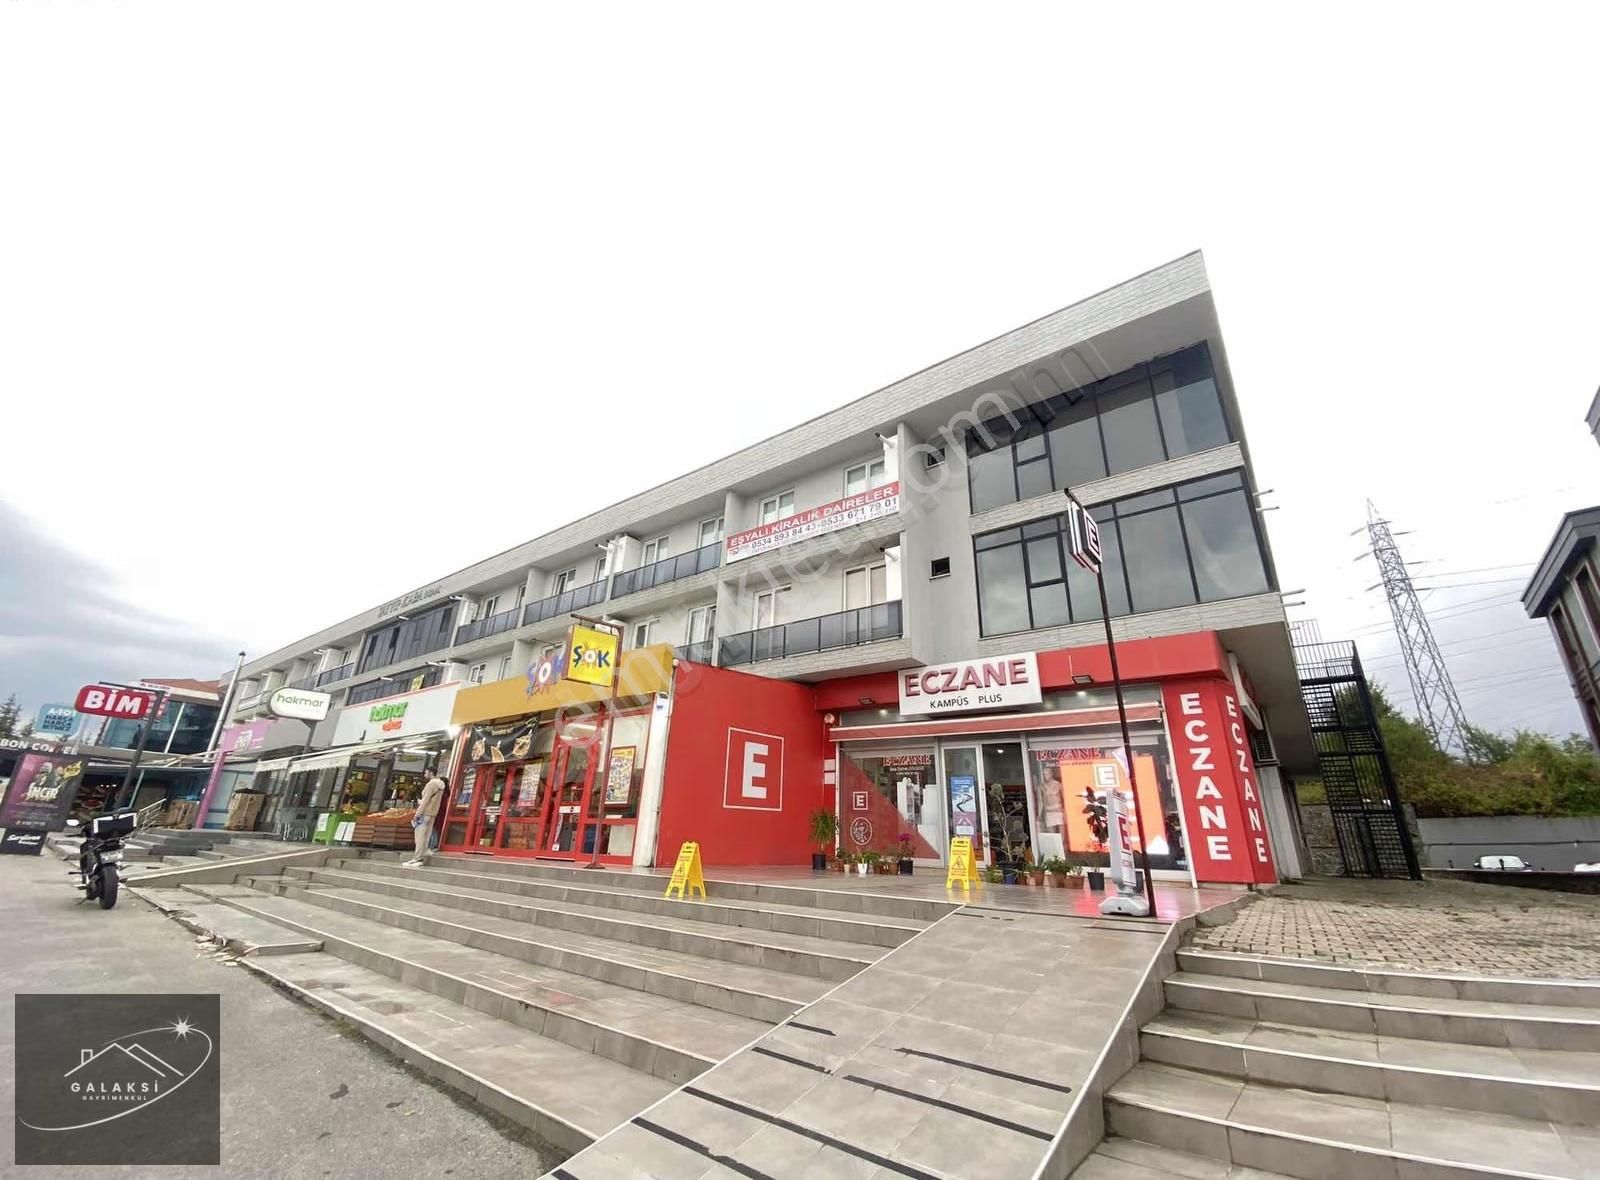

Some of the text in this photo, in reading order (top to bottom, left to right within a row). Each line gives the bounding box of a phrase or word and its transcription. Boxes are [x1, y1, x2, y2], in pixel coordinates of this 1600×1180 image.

[730, 528, 770, 547] EŞYALI
[771, 510, 820, 533] KİRALIK
[823, 486, 894, 516] DAİRELER
[752, 537, 772, 549] 0534
[774, 532, 790, 542] 893
[792, 527, 803, 537] 84
[847, 507, 865, 519] 671
[868, 502, 882, 513] 79
[885, 497, 897, 508] 01
[1088, 520, 1099, 552] E
[572, 645, 610, 668] ŞOK
[904, 659, 1029, 697] ECZANE
[83, 690, 142, 715] BİM
[276, 692, 325, 708] hakmar
[930, 693, 1003, 709] KAMPÜS PLUS
[742, 741, 768, 799] E
[883, 754, 932, 767] ECZANE
[1098, 766, 1115, 785] E
[1179, 692, 1232, 861] ECZANE
[1225, 695, 1268, 863] ECZANE
[856, 795, 865, 807] E
